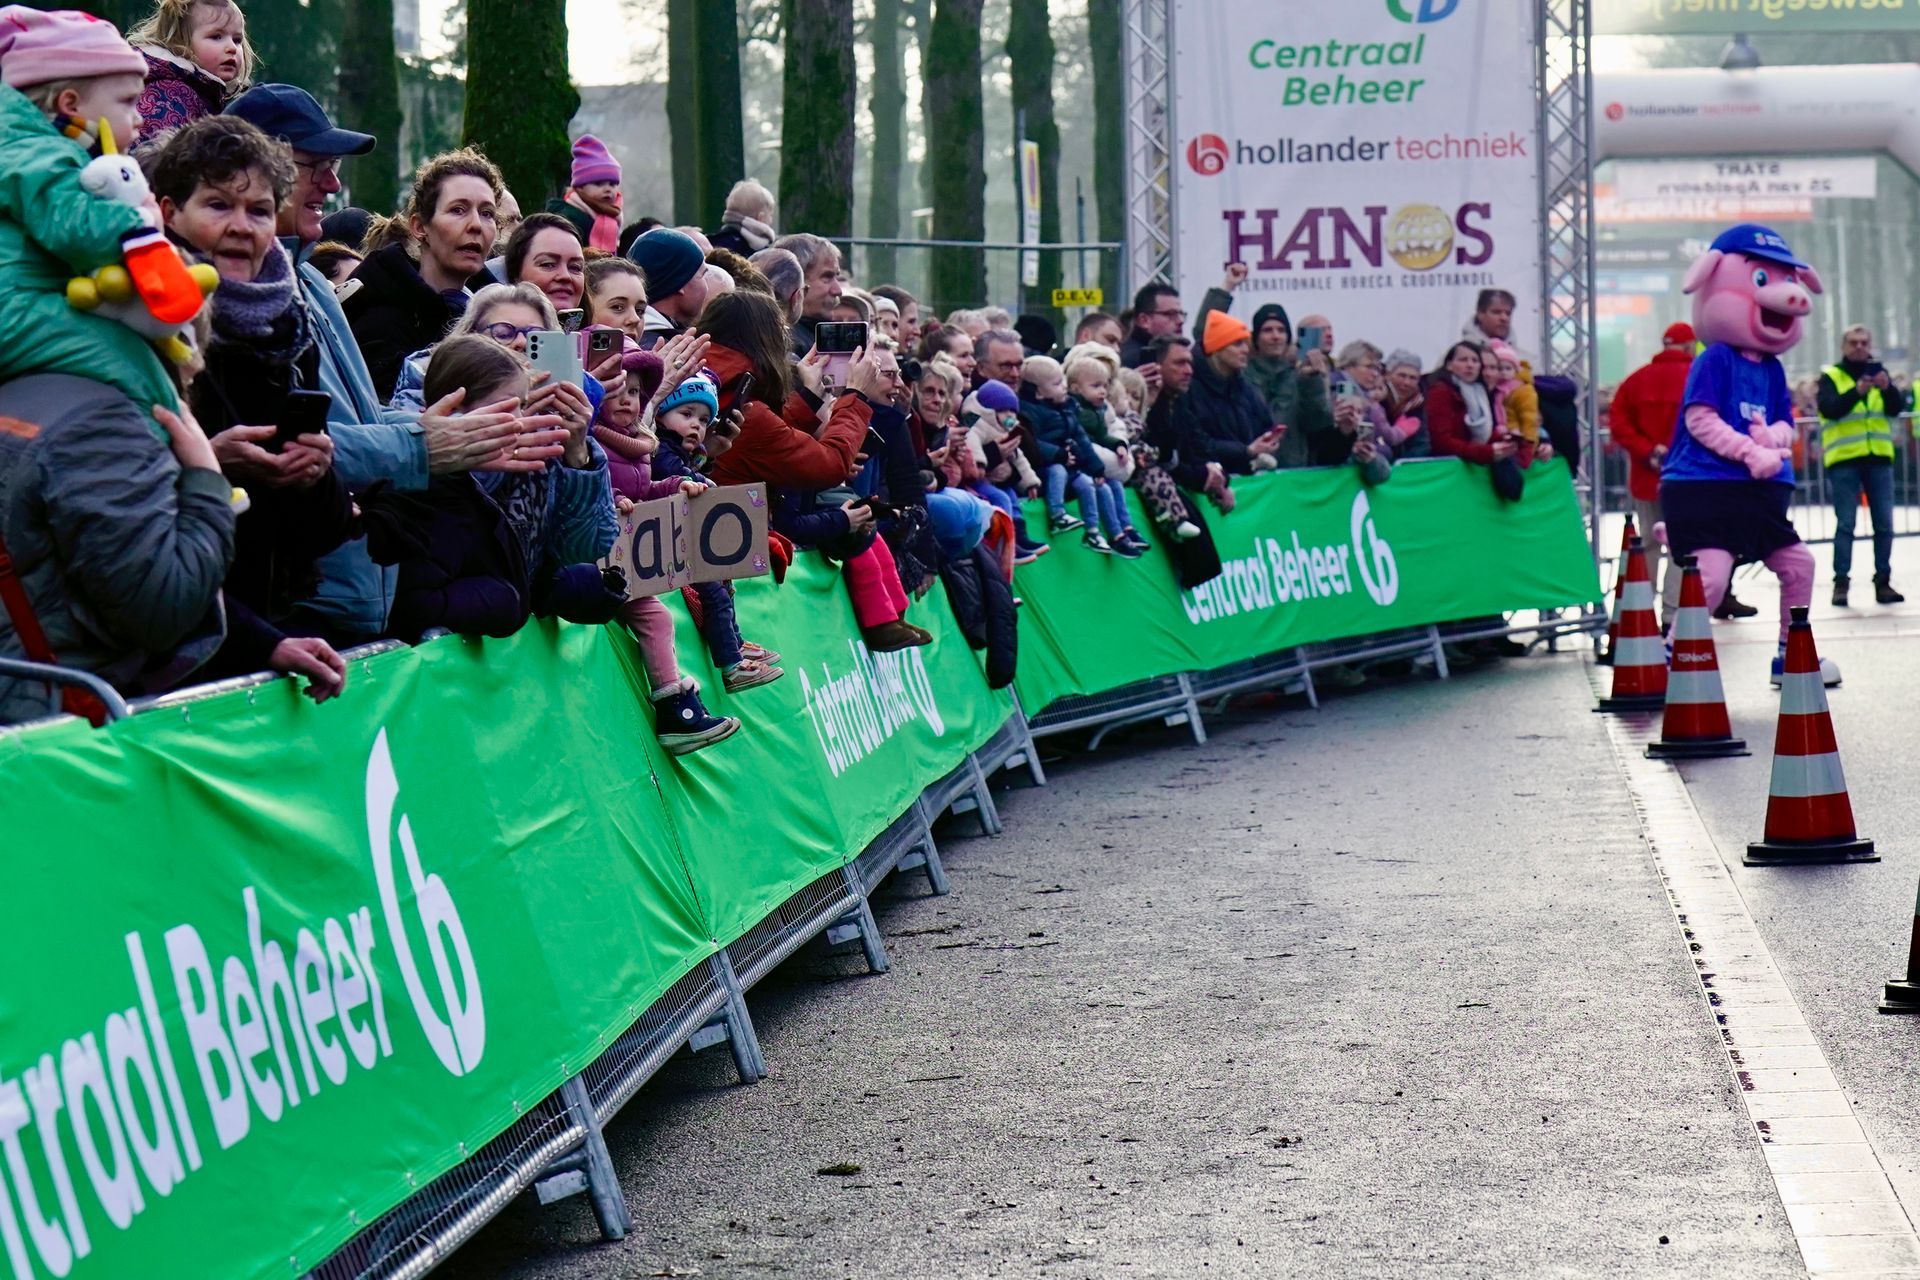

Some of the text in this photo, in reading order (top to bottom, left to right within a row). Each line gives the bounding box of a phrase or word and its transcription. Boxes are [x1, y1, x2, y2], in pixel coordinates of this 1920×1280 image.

[1249, 33, 1425, 69] Centraal
[1282, 74, 1425, 106] Beheer
[1236, 131, 1527, 165] hollander techniek
[1222, 202, 1494, 271] HANOS
[1055, 290, 1096, 301] D.E.V.
[1239, 272, 1495, 292] ERNATIONALE HORECA GROOTHANDEL
[1265, 530, 1352, 604] Beheer
[164, 885, 394, 1150] Beheer
